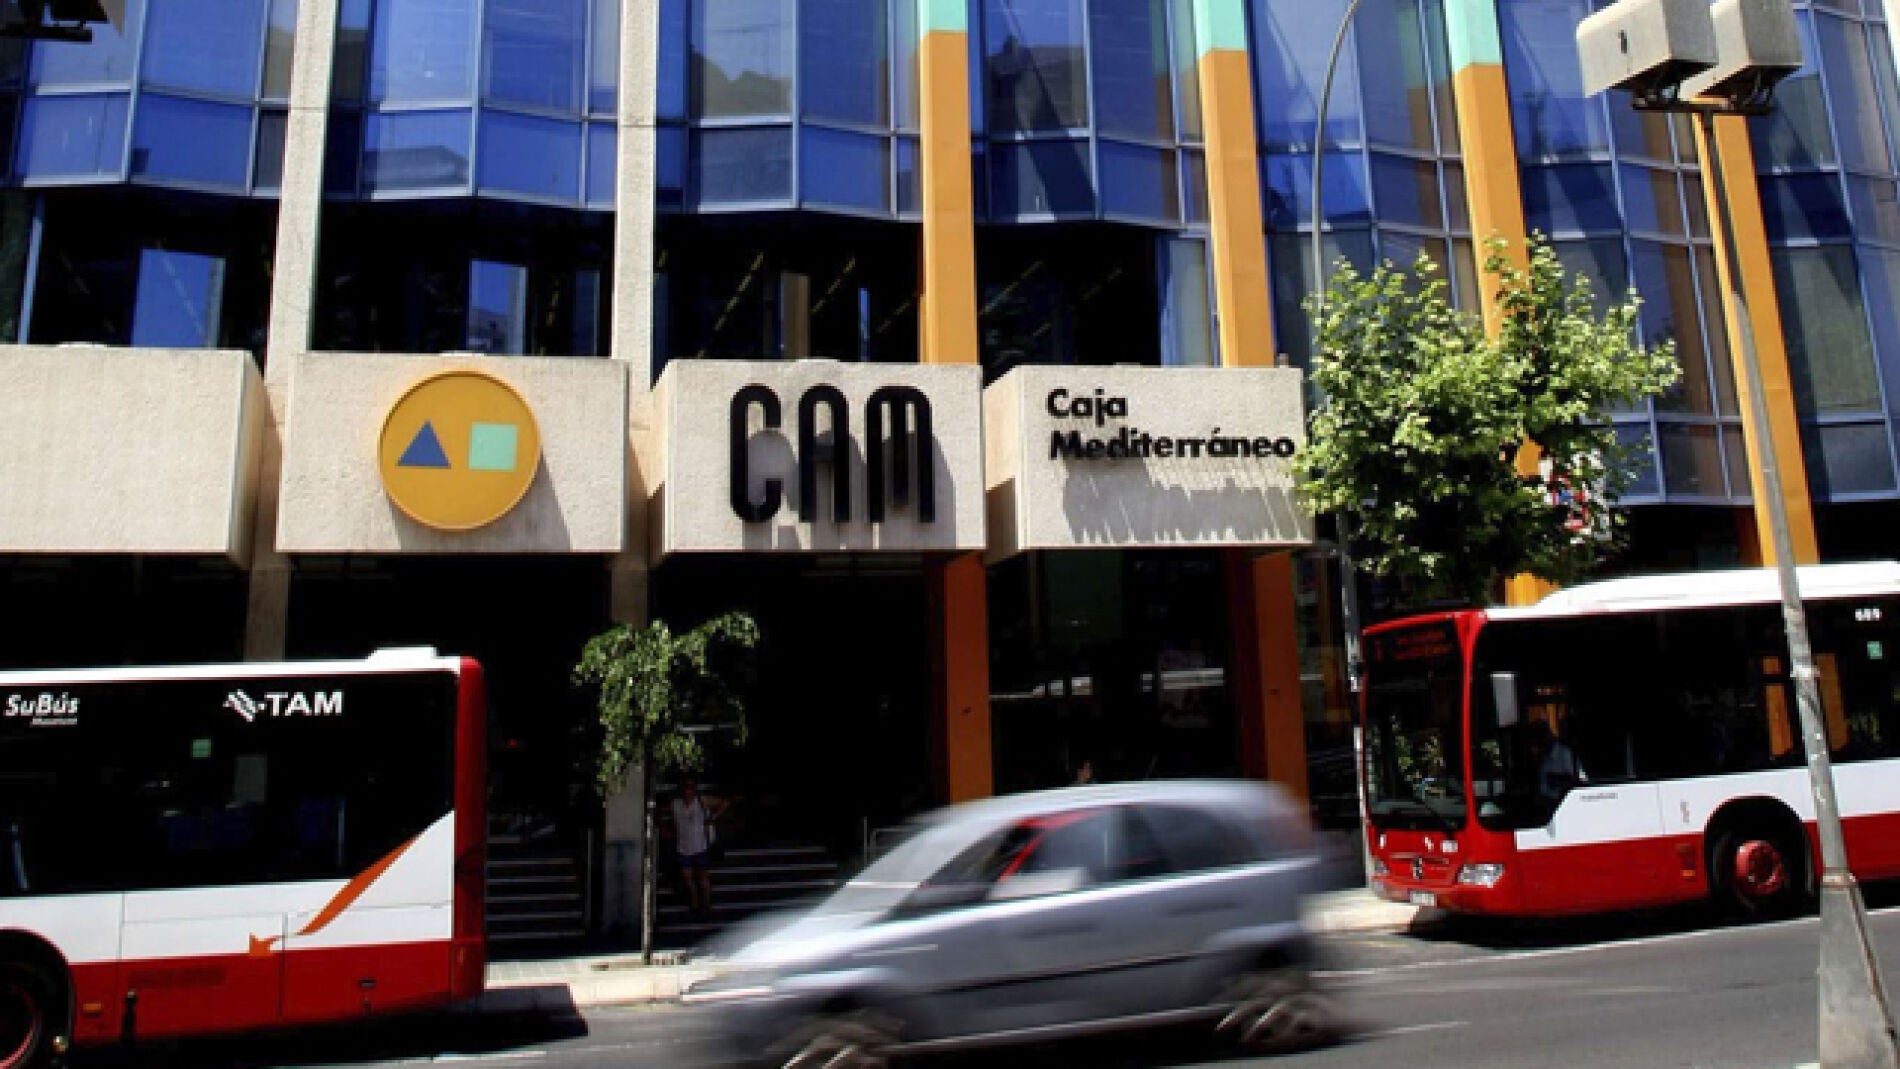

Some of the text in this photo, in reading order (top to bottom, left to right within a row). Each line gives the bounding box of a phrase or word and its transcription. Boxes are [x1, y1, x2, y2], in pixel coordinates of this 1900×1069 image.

[1048, 388, 1128, 427] Caja
[730, 384, 935, 522] CAM
[1051, 427, 1296, 460] Mediterráneo
[264, 691, 343, 716] TAM
